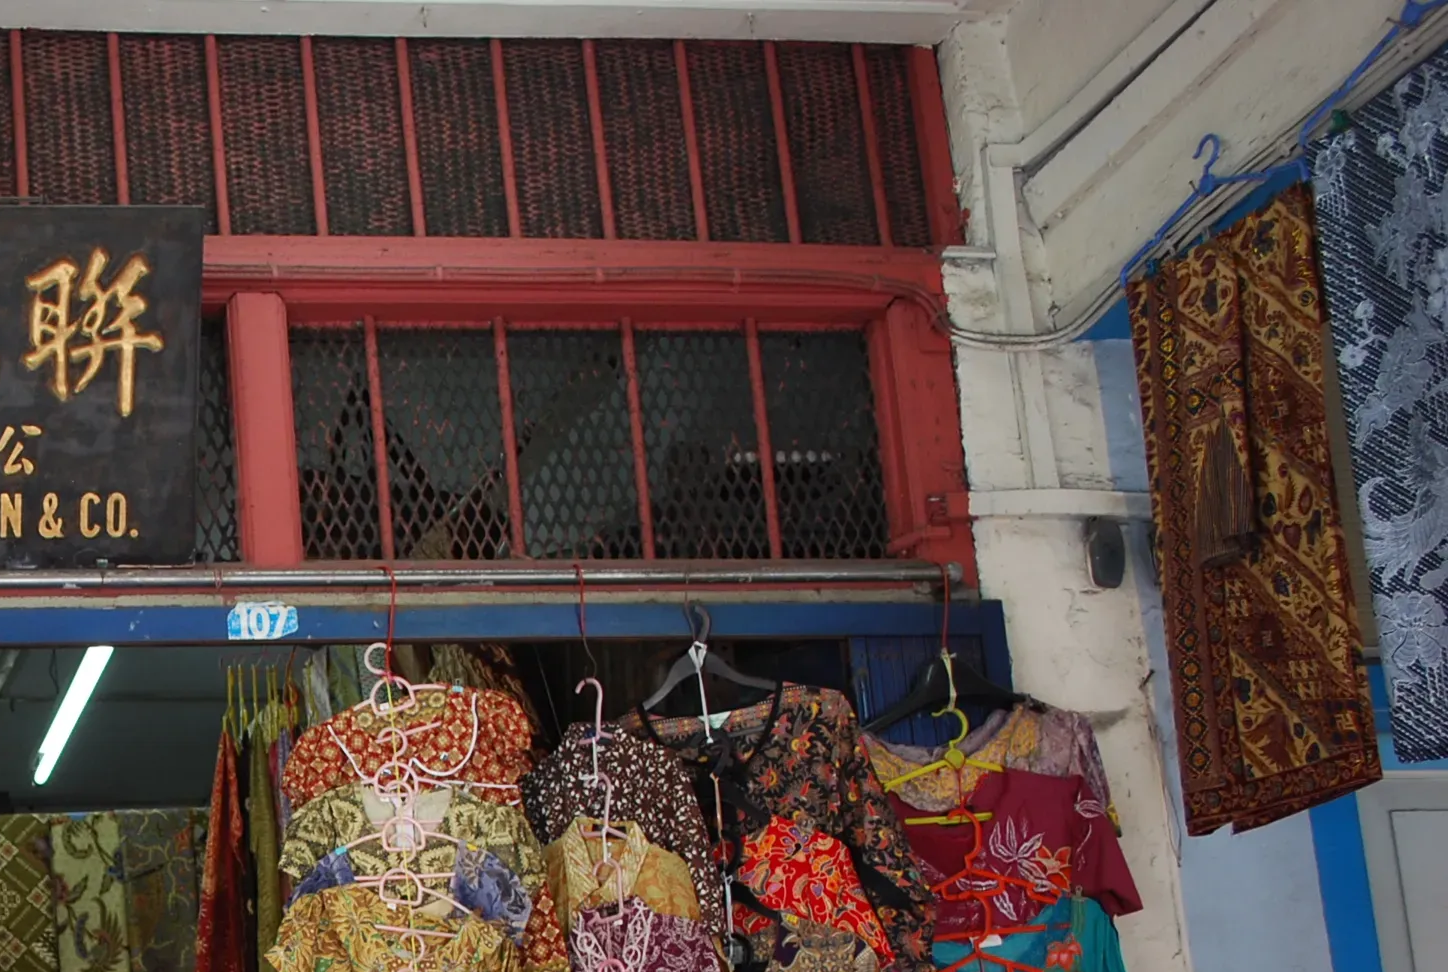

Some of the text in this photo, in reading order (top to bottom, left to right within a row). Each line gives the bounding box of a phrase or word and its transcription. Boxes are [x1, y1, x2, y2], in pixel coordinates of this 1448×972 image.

[38, 492, 65, 539] &
[79, 492, 140, 540] CO.
[234, 605, 289, 640] 107
